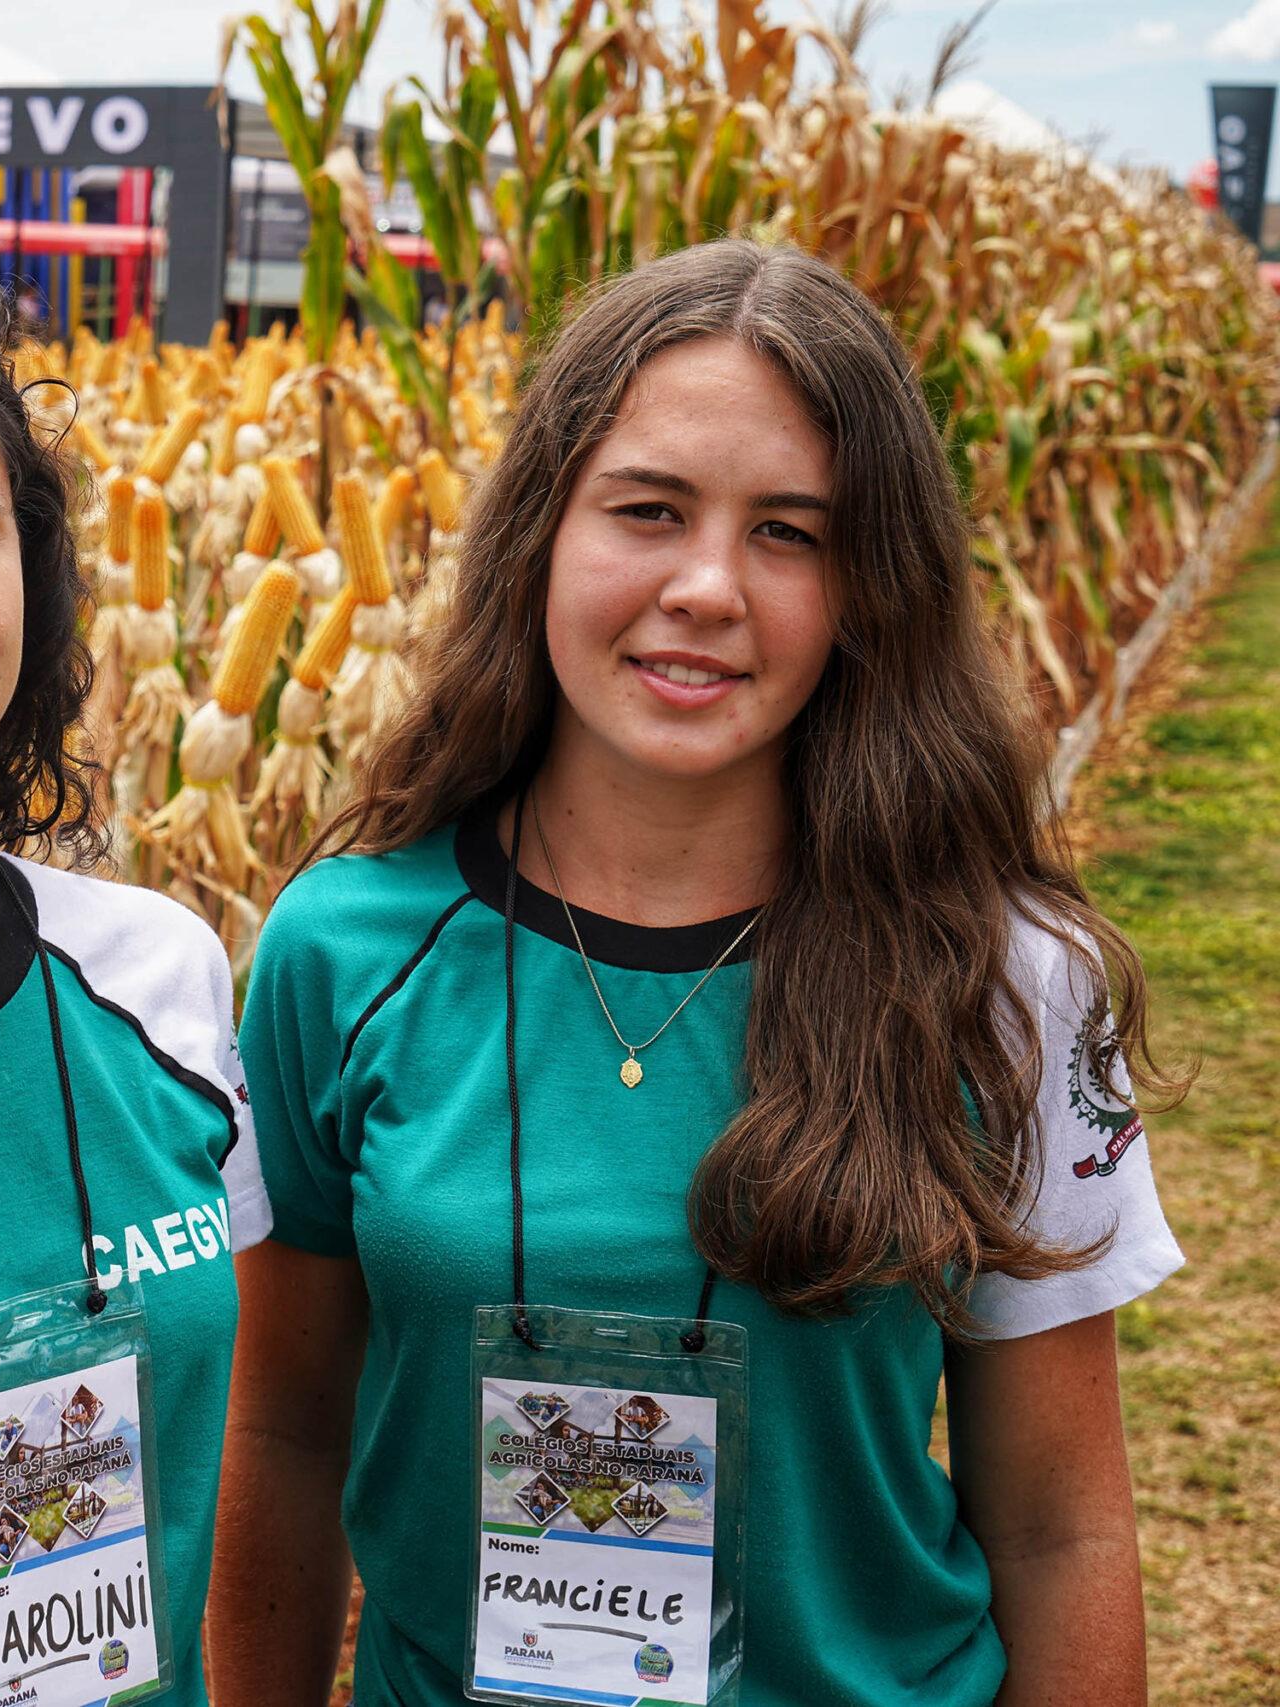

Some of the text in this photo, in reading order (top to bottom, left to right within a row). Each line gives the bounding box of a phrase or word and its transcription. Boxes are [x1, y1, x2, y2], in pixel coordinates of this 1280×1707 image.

[82, 1198, 231, 1290] CAEGV
[43, 1436, 124, 1470] ESTADUAIS
[499, 1433, 695, 1465] COLÉGIOS ESTADUAIS
[47, 1471, 69, 1488] NO
[71, 1451, 132, 1481] PARANÁ
[489, 1451, 705, 1485] AGRÍCOLAS NO PARANÁ
[488, 1538, 540, 1555] Nome:
[504, 1645, 554, 1661] PARANÁ
